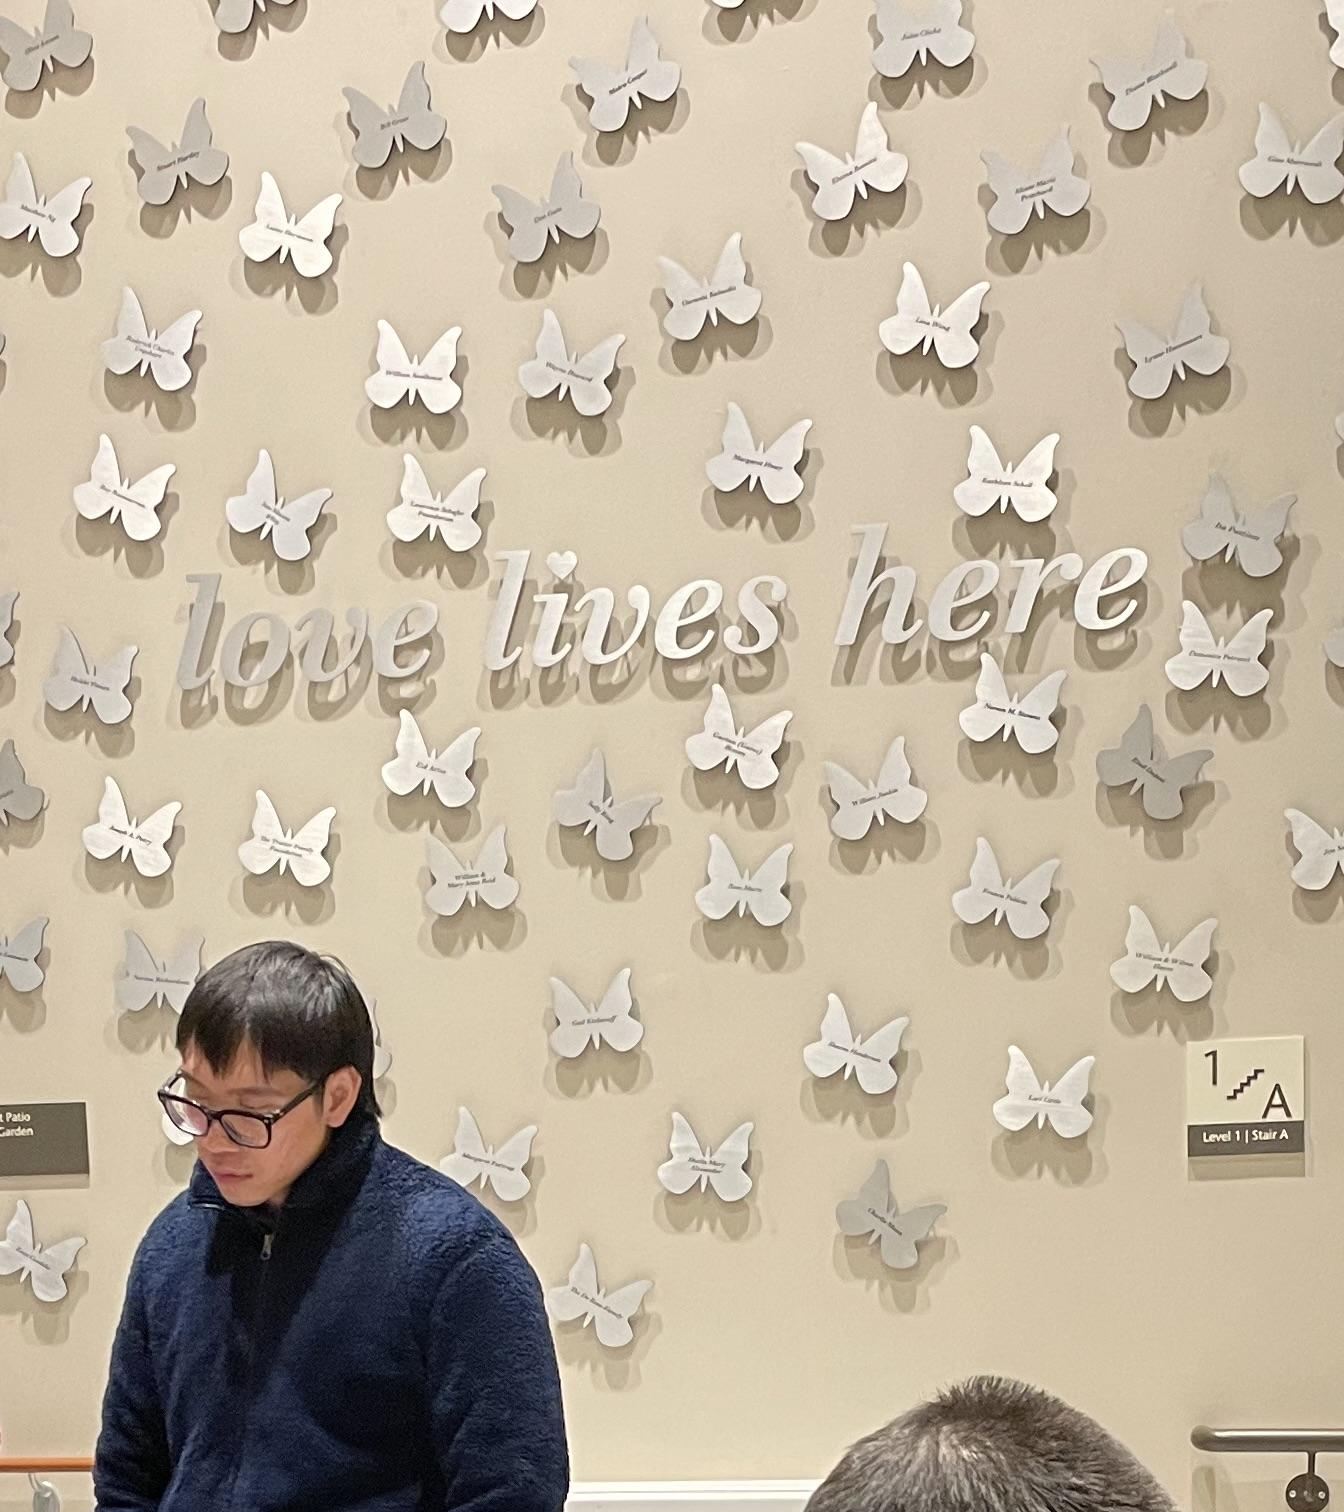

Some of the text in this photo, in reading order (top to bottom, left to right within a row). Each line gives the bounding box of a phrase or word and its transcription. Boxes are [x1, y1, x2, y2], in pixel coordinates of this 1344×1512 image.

[179, 523, 1149, 690] love lives here
[1204, 1049, 1218, 1086] 1
[5, 1112, 31, 1123] Patio
[1261, 1083, 1292, 1119] A
[1202, 1130, 1232, 1143] Level
[1235, 1130, 1241, 1141] 1
[1251, 1129, 1277, 1140] Stair
[1279, 1128, 1289, 1140] A
